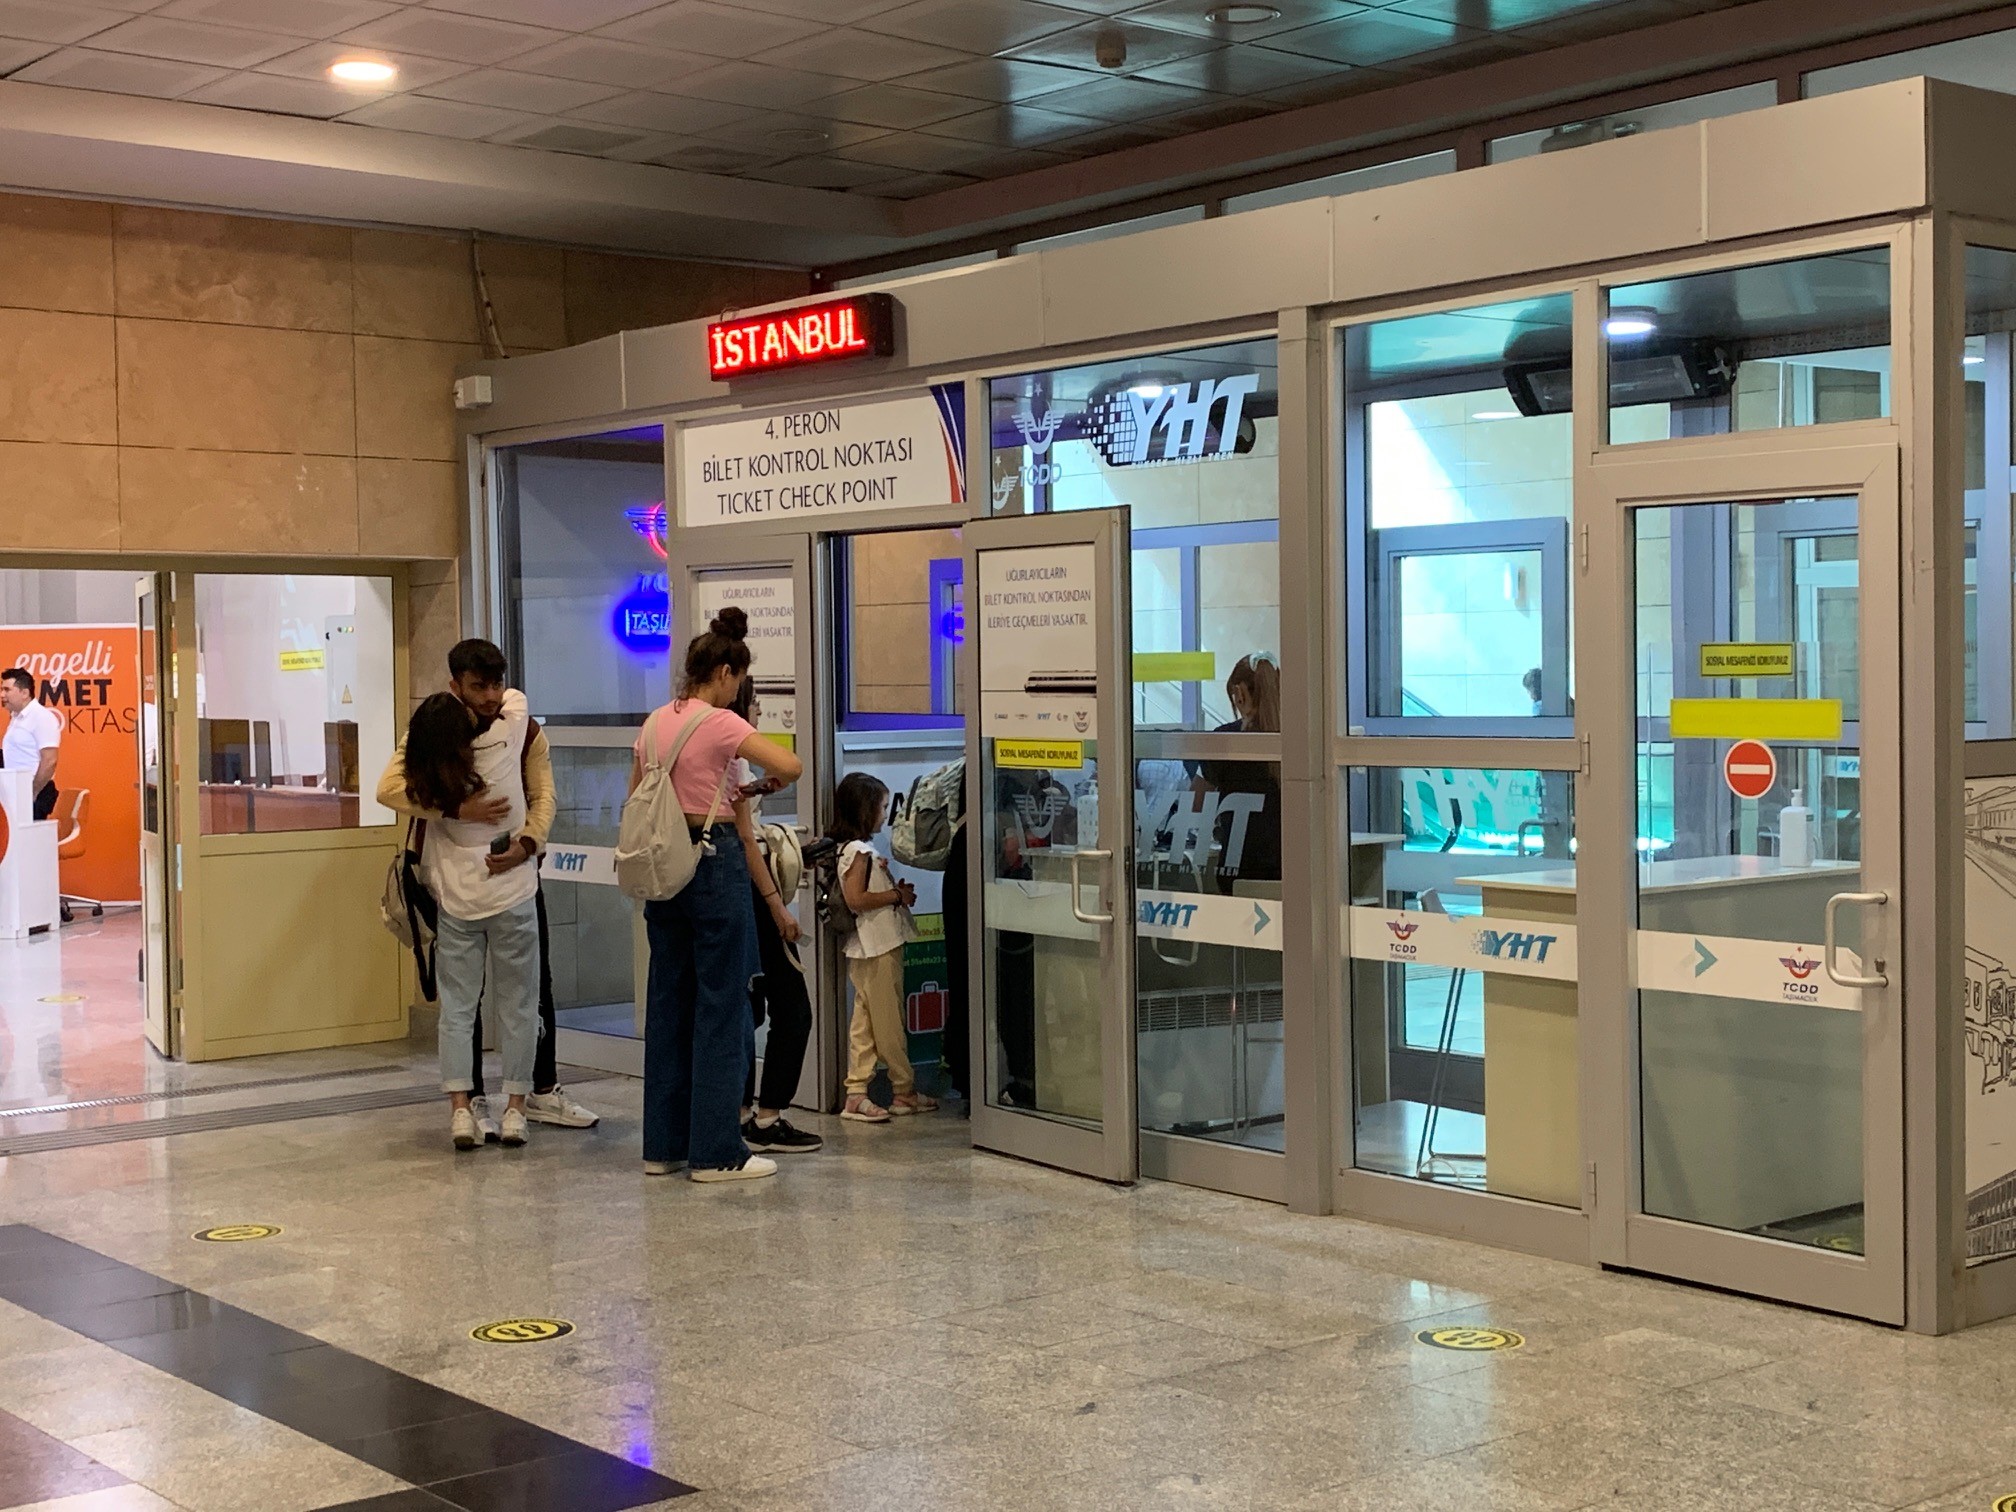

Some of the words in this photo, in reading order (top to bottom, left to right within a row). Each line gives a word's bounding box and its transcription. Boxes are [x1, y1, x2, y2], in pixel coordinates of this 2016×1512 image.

[711, 307, 866, 370] İSTANBUL
[765, 418, 779, 440] 4.
[784, 409, 840, 438] PERON
[1126, 373, 1260, 461] YHT
[703, 454, 743, 483] BİLET
[749, 447, 829, 477] KONTROL
[834, 437, 913, 467] NOKTASI
[1208, 451, 1234, 461] TREN
[1018, 463, 1062, 487] TCDD
[717, 488, 774, 515] TICKET
[779, 482, 837, 510] CHECK
[843, 476, 898, 504] POINT
[1003, 591, 1037, 605] KONTROL
[1038, 589, 1091, 603] NOKTASINDAN
[632, 613, 669, 634] TAŞI
[14, 640, 115, 687] engelli
[1134, 790, 1265, 867] YHT
[556, 852, 588, 872] YHT
[1213, 866, 1239, 877] TREN
[1147, 901, 1198, 928] YHT
[1389, 943, 1417, 954] TCDD
[1490, 930, 1557, 962] YHT
[1783, 982, 1819, 994] TCDD
